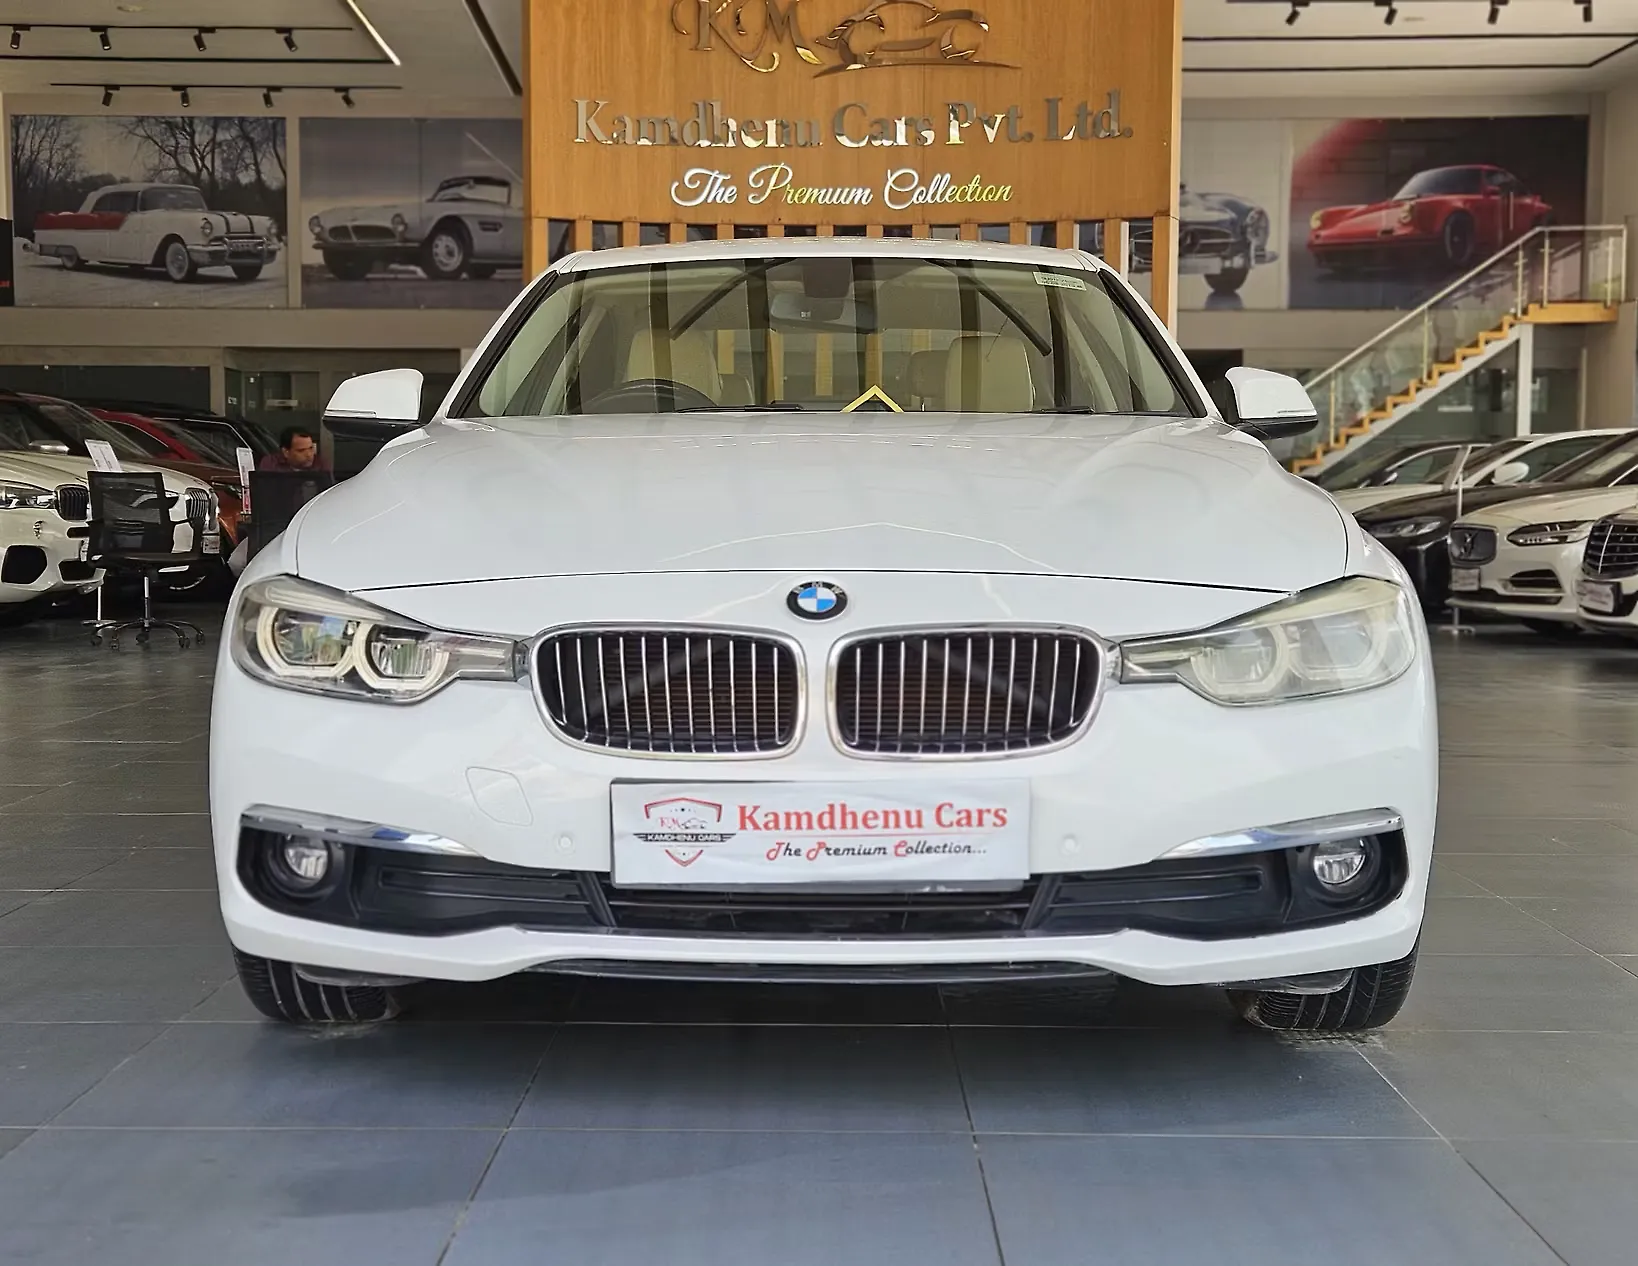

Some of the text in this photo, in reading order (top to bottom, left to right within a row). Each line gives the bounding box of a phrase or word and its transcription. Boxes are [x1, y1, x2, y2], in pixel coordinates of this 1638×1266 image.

[574, 89, 1134, 148] Kamdhenu Cars Pvt. Ltd.
[670, 162, 1014, 209] The Premium Collection
[738, 802, 1008, 831] Kamdhenu Cars
[766, 840, 987, 861] The Premium Collection...
